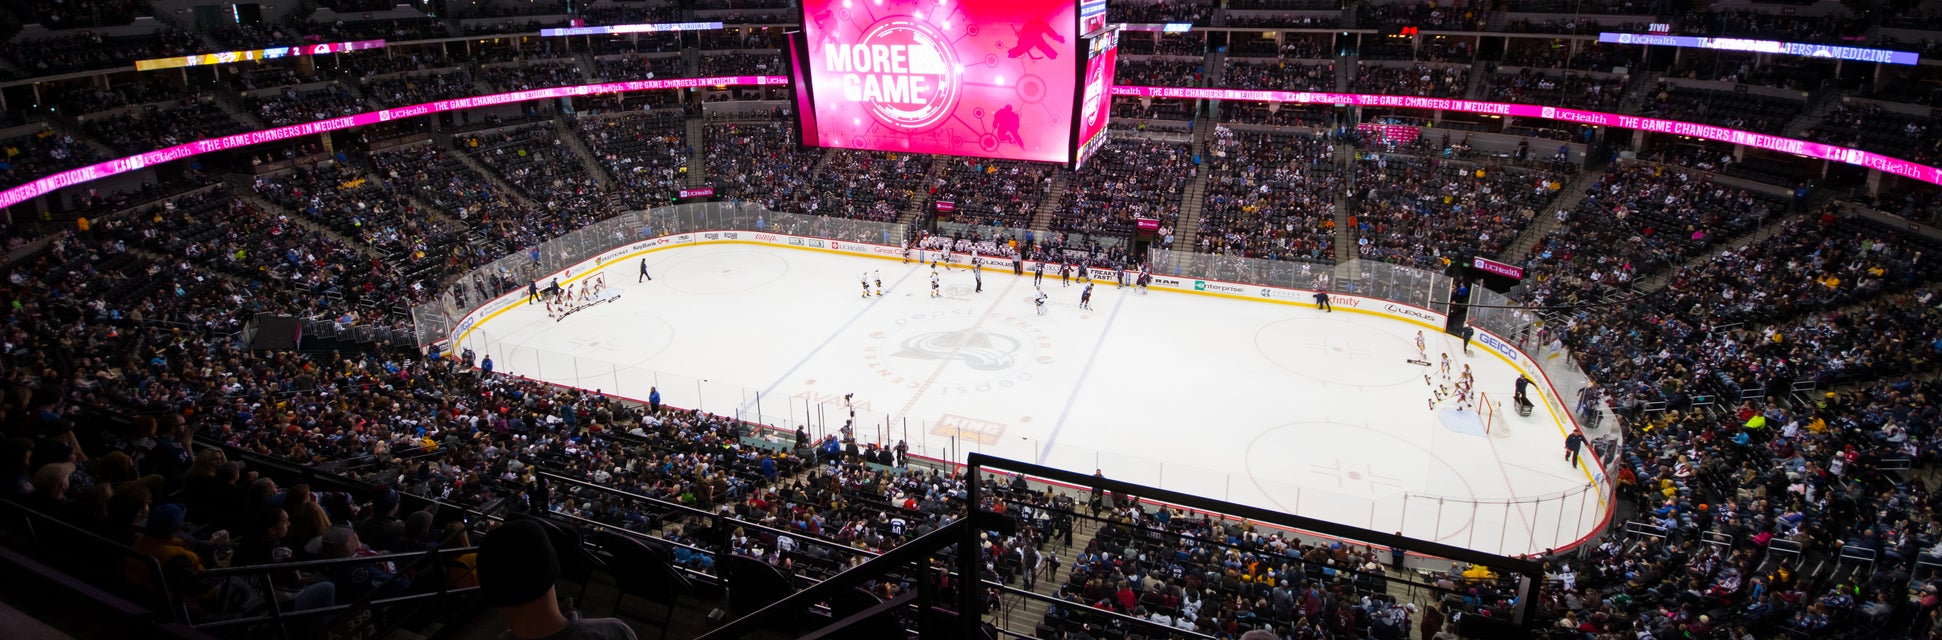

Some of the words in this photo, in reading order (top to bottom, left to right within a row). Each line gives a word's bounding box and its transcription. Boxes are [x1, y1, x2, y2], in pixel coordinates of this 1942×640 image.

[1631, 35, 1676, 46] UCHealth
[293, 46, 300, 56] 2
[1832, 46, 1892, 64] MEDICINE
[825, 44, 907, 73] MORE
[630, 82, 643, 90] THE
[644, 80, 662, 89] GAME
[664, 78, 698, 88] CHANGERS
[698, 78, 706, 86] IN
[706, 76, 738, 86] MEDICINE
[844, 74, 926, 104] GAME
[1149, 88, 1162, 96] THE
[1164, 88, 1184, 97] GAME
[1185, 89, 1224, 98] CHANGERS
[434, 102, 448, 112] THE
[450, 98, 472, 110] GAME
[472, 94, 510, 107] CHANGERS
[1362, 95, 1378, 104] THE
[1380, 96, 1404, 106] GAME
[1405, 98, 1450, 110] CHANGERS
[1452, 101, 1462, 110] IN
[1464, 102, 1510, 114] MEDICINE
[390, 106, 428, 118] UCHealth
[1556, 110, 1606, 124] UCHealth
[200, 140, 220, 152] THE
[223, 134, 250, 148] GAME
[252, 126, 300, 144] CHANGERS
[302, 124, 312, 134] IN
[314, 116, 354, 132] MEDICINE
[1618, 116, 1638, 128] THE
[1642, 120, 1672, 132] GAME
[1674, 124, 1730, 140] CHANGERS
[1732, 130, 1744, 143] IN
[1746, 134, 1804, 153] MEDICINE
[144, 147, 192, 165] UCHealth
[1864, 156, 1920, 178] UCHealth
[49, 166, 97, 190] MEDICINE
[754, 233, 778, 242] AVAYA
[633, 240, 656, 250] KeyBank
[840, 243, 866, 252] UCHealth
[602, 250, 628, 262] DRAFTKINGS
[986, 260, 1014, 268] LEXUS
[1484, 264, 1520, 278] UCHealth
[1090, 269, 1118, 277] FREAKY
[1398, 308, 1435, 322] LEXUS
[453, 316, 474, 340] GEICO
[1479, 334, 1518, 361] GEICO
[347, 608, 372, 632] 339
